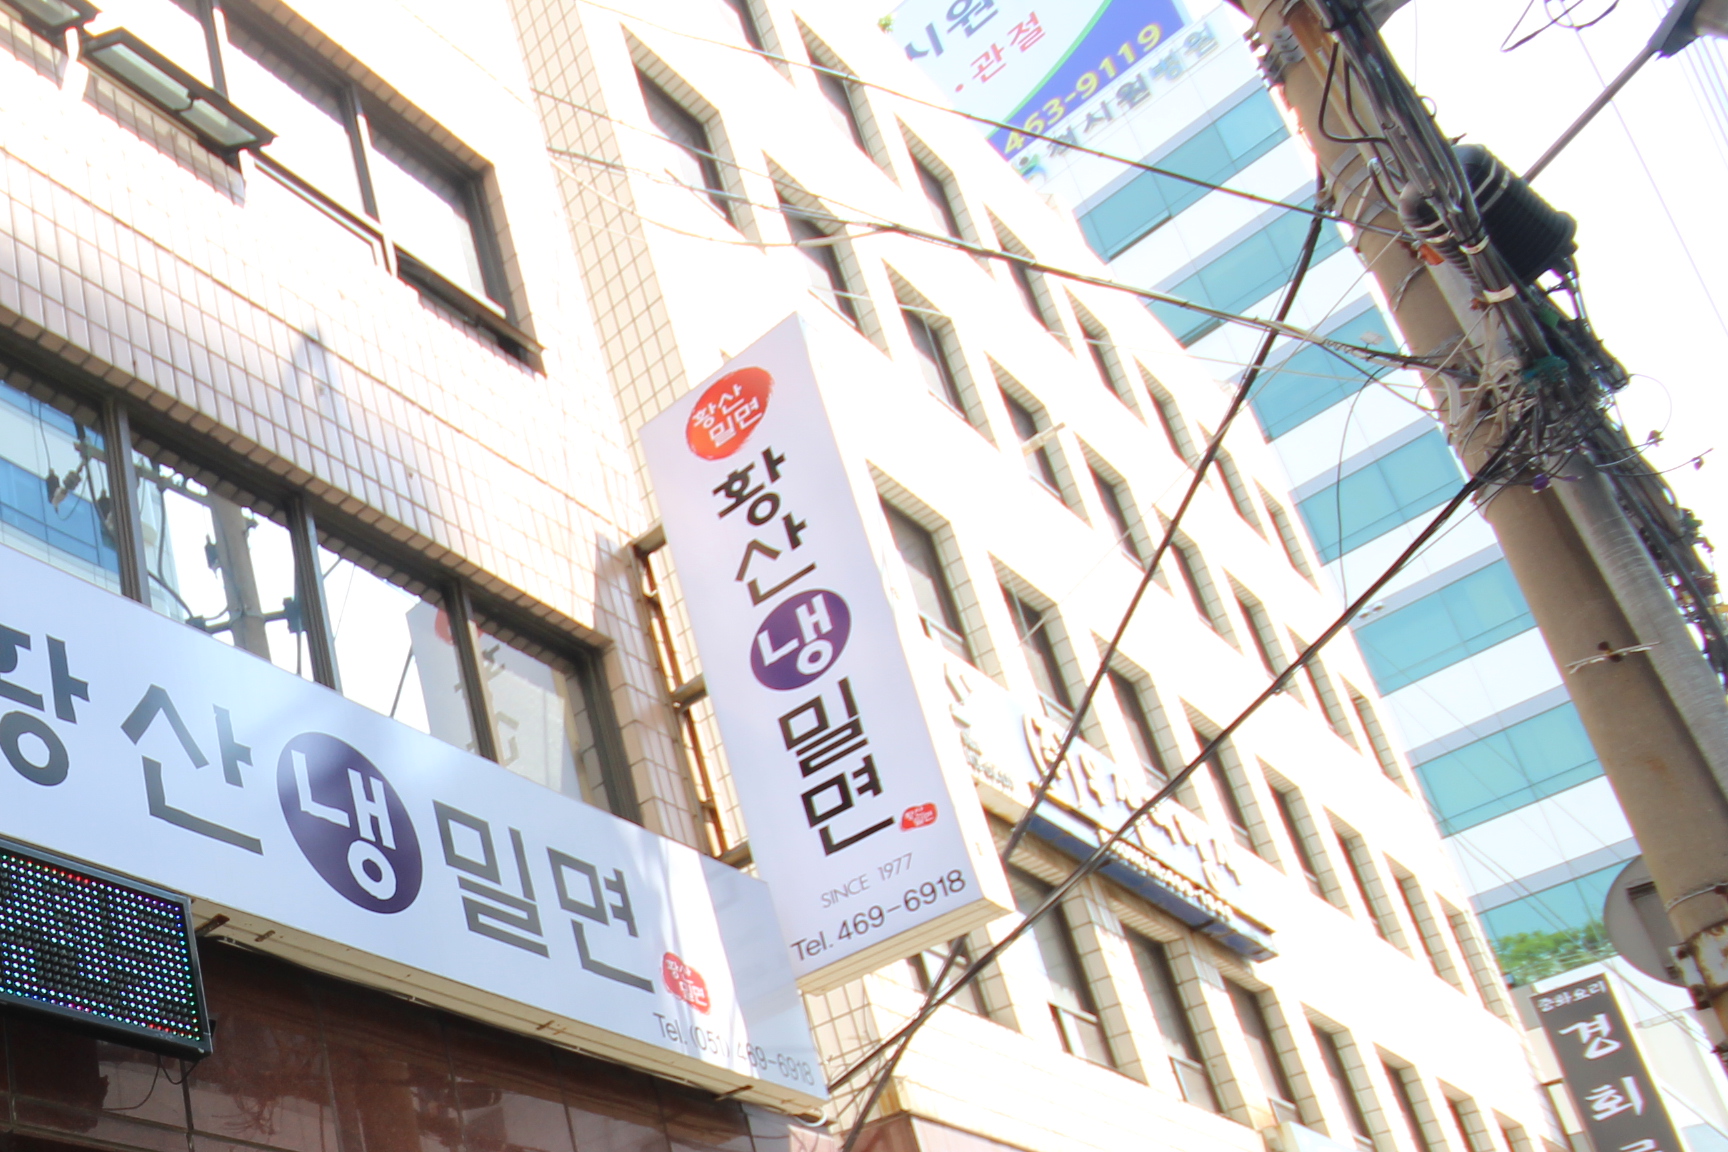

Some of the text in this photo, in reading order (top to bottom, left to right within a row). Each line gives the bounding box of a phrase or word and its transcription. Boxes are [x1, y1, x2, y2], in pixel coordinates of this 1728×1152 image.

[971, 11, 1046, 83] 관절
[1005, 22, 1163, 154] 463-9119
[691, 383, 744, 429] 황산
[709, 397, 763, 448] 밀면
[821, 852, 913, 909] SINCE 1977
[789, 868, 967, 961] Tel. 469-6918
[1537, 980, 1607, 1013] 중화요리
[653, 1012, 688, 1046] Tel.
